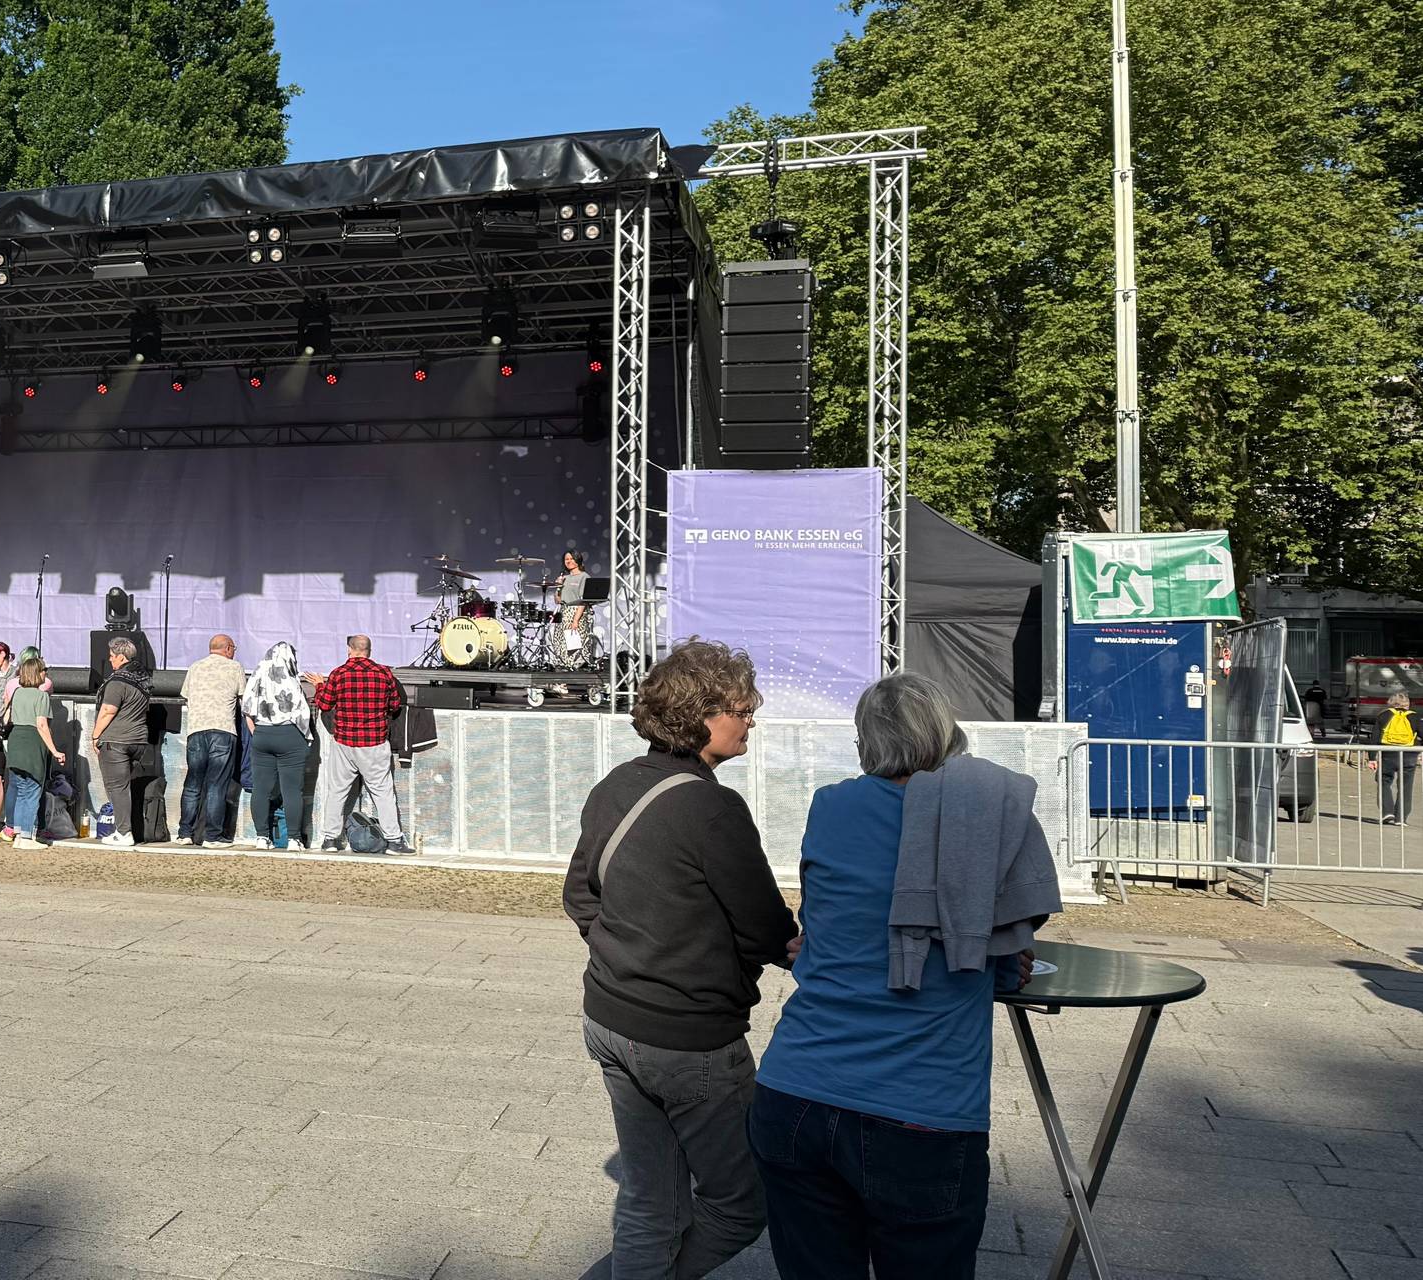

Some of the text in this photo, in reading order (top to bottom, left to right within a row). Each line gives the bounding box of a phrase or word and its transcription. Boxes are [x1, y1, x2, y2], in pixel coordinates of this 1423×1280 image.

[711, 529, 863, 541] GENO BANK ESSEN eG
